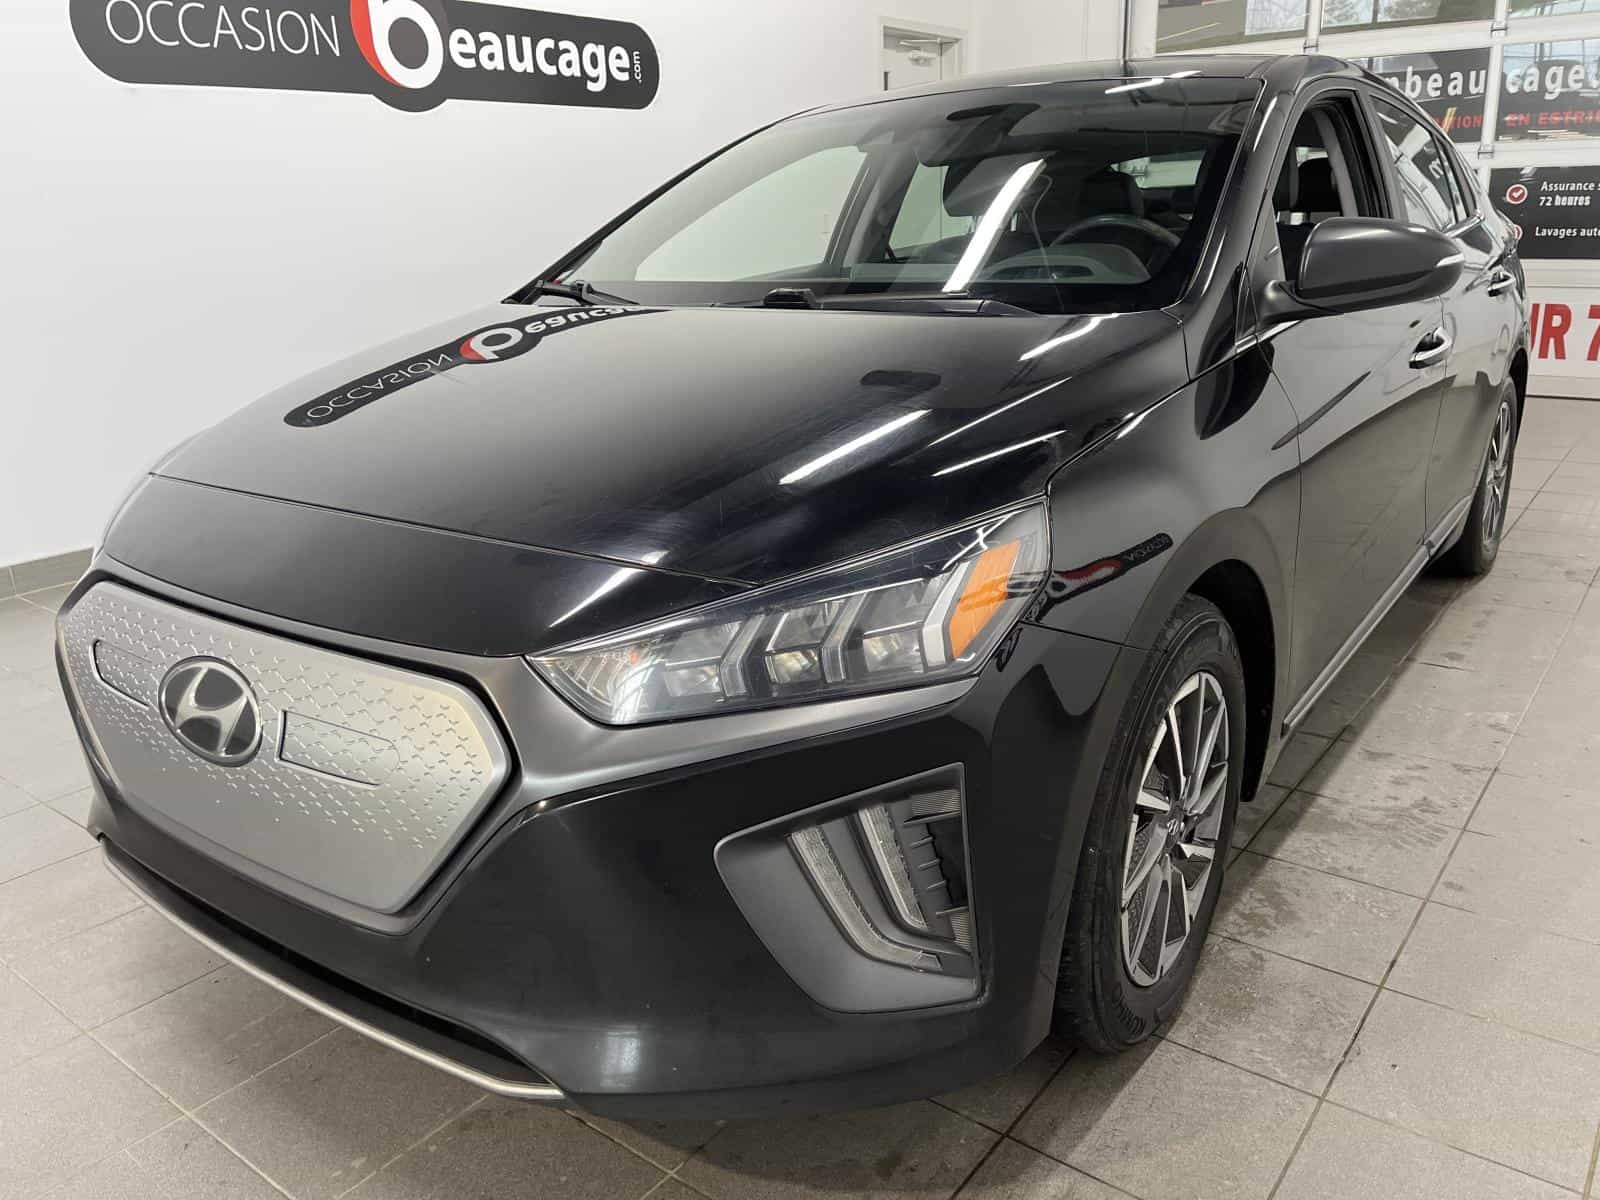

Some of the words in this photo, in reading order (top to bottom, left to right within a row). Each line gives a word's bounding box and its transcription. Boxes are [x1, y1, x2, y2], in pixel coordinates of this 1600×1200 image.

[105, 0, 340, 57] OCCASION
[1540, 181, 1595, 192] Assurance
[1539, 196, 1553, 206] 72
[1535, 226, 1577, 239] Lavages
